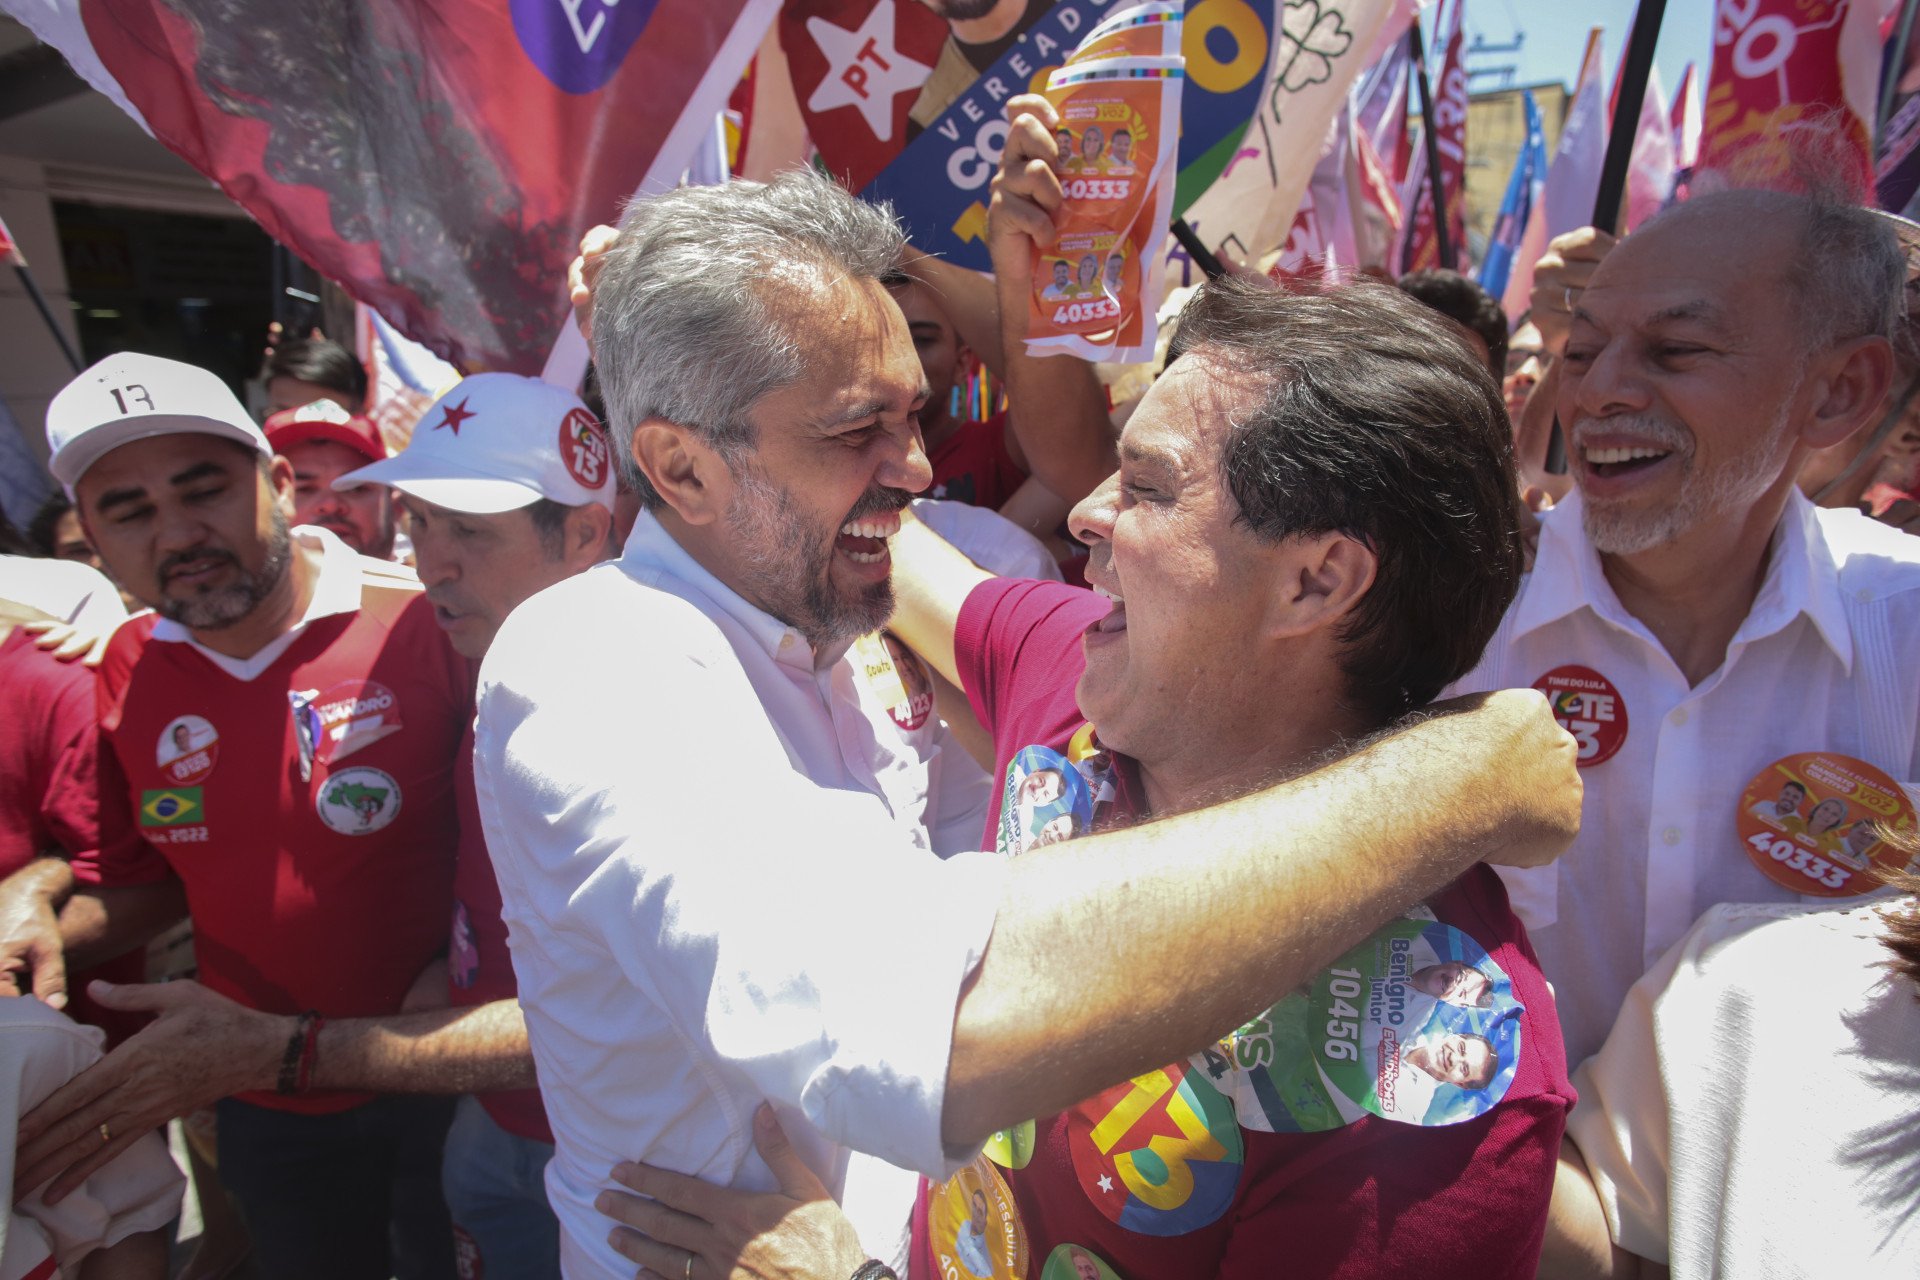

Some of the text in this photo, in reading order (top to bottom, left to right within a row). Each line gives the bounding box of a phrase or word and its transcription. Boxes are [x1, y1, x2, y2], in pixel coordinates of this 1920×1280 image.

[841, 37, 892, 99] PT
[573, 445, 600, 483] 13
[1548, 676, 1607, 690] TIME DO LULA
[1806, 768, 1851, 794] COLETIVO
[1808, 762, 1856, 789] MANDATO
[1859, 789, 1894, 811] VOZ
[1747, 831, 1852, 889] 40333
[1385, 938, 1411, 1026] Benigno
[1323, 967, 1362, 1062] 10456
[1382, 1028, 1397, 1094] EVANDRO
[1090, 1069, 1229, 1211] 13
[992, 1189, 1016, 1268] MESQUITA
